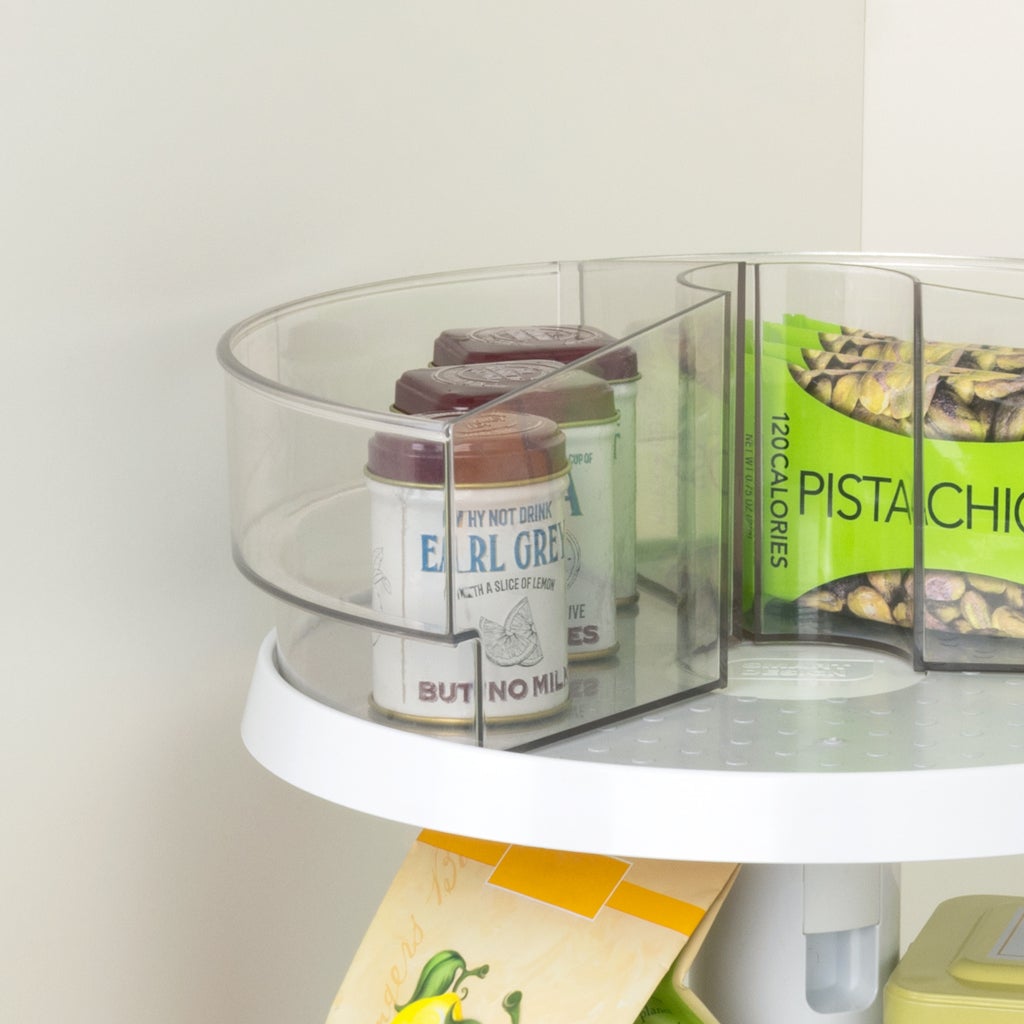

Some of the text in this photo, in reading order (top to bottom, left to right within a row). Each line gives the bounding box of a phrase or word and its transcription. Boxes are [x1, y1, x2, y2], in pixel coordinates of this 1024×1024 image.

[489, 508, 517, 527] NOT
[519, 501, 552, 525] DRINK
[769, 453, 789, 569] CALORIES
[486, 582, 493, 595] A
[494, 577, 520, 593] SLICE
[521, 577, 532, 590] OF
[419, 681, 473, 703] BUT
[488, 678, 528, 702] NO
